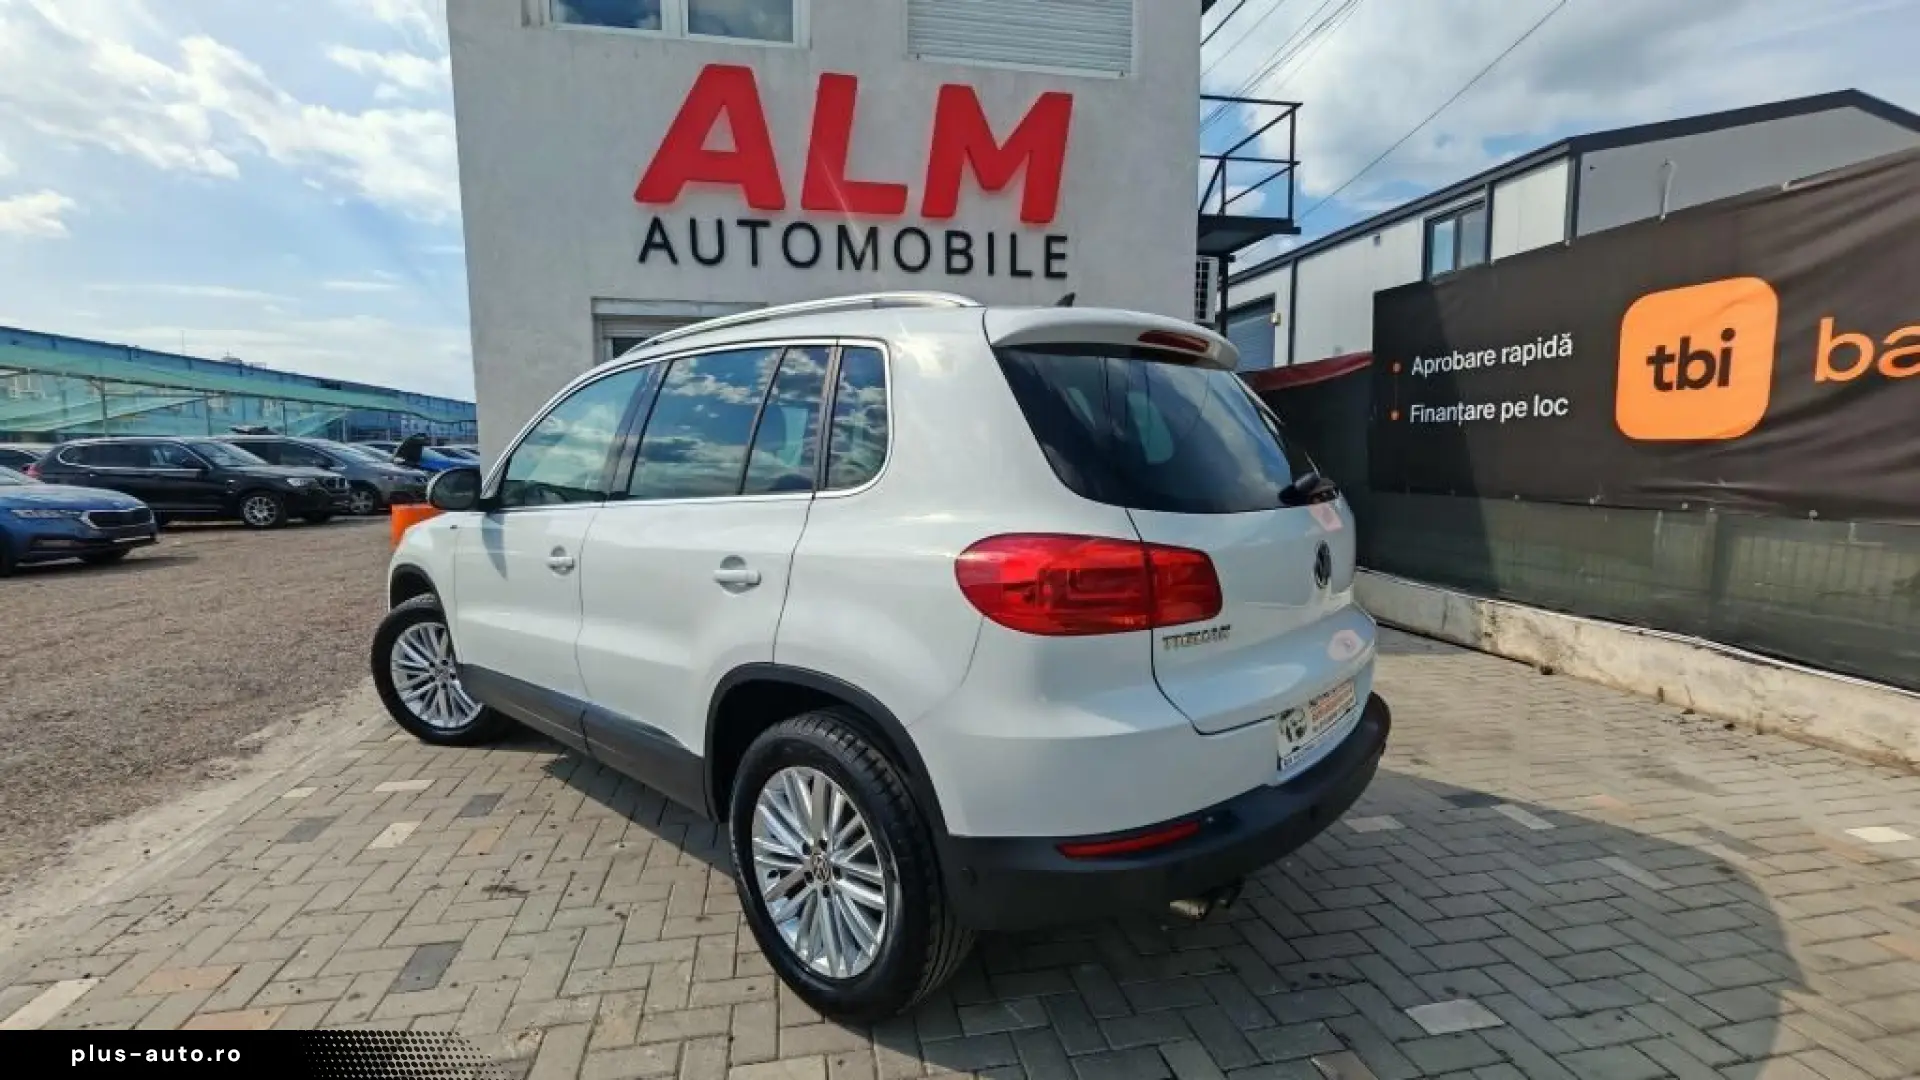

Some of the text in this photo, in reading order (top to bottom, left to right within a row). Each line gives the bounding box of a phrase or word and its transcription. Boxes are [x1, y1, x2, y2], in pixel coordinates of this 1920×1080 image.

[634, 63, 1074, 224] ALM
[638, 216, 1069, 279] AUTOMOBILE
[1411, 332, 1573, 378] Aprobare rapidă
[1646, 327, 1736, 392] tbi
[1410, 394, 1569, 426] Finanțare pe loc
